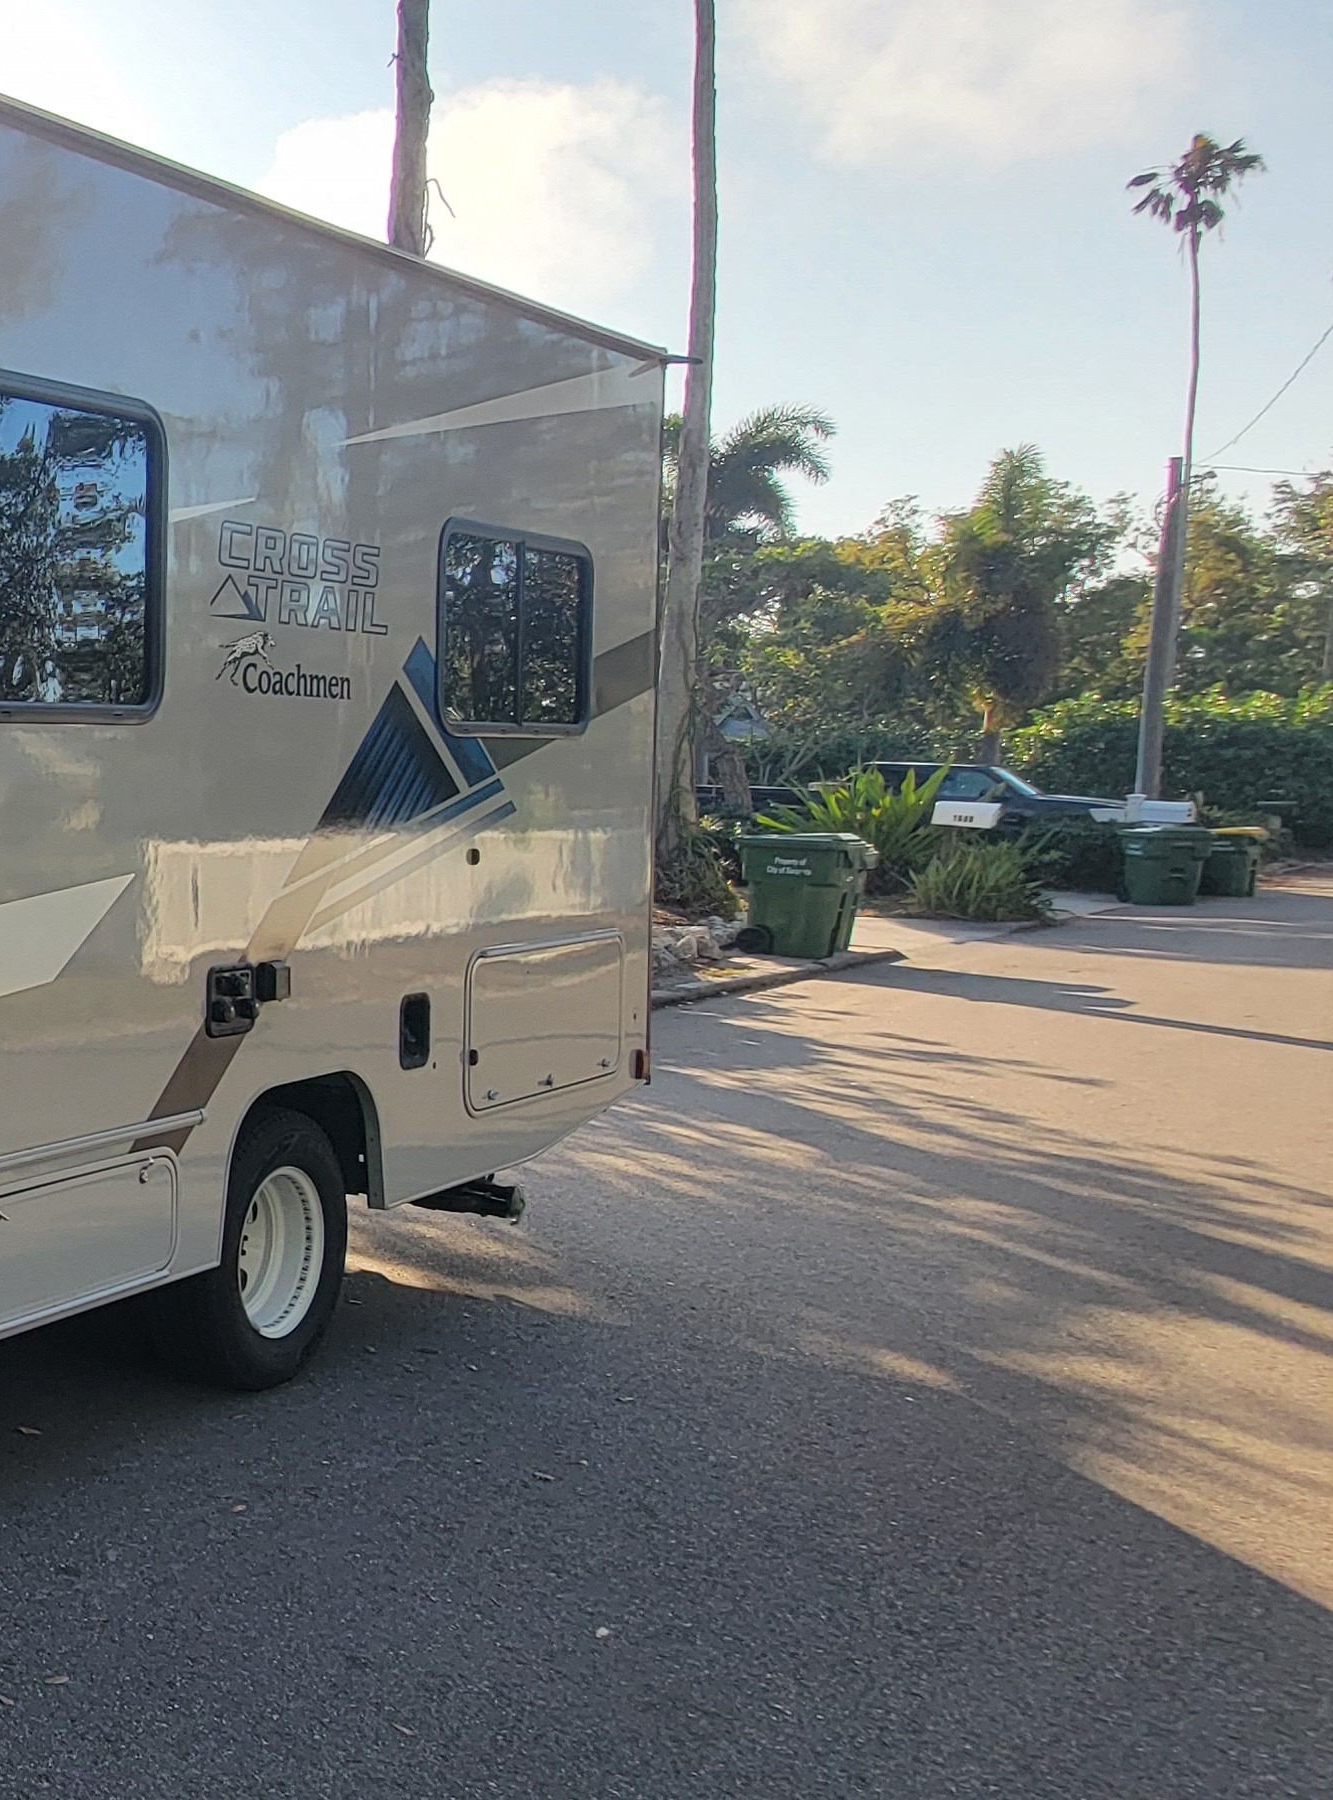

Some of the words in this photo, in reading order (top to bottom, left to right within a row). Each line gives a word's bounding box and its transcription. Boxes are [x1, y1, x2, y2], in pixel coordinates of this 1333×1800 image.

[218, 520, 381, 588] CROSS
[247, 574, 389, 636] TRAIL
[242, 662, 352, 700] Coachmen
